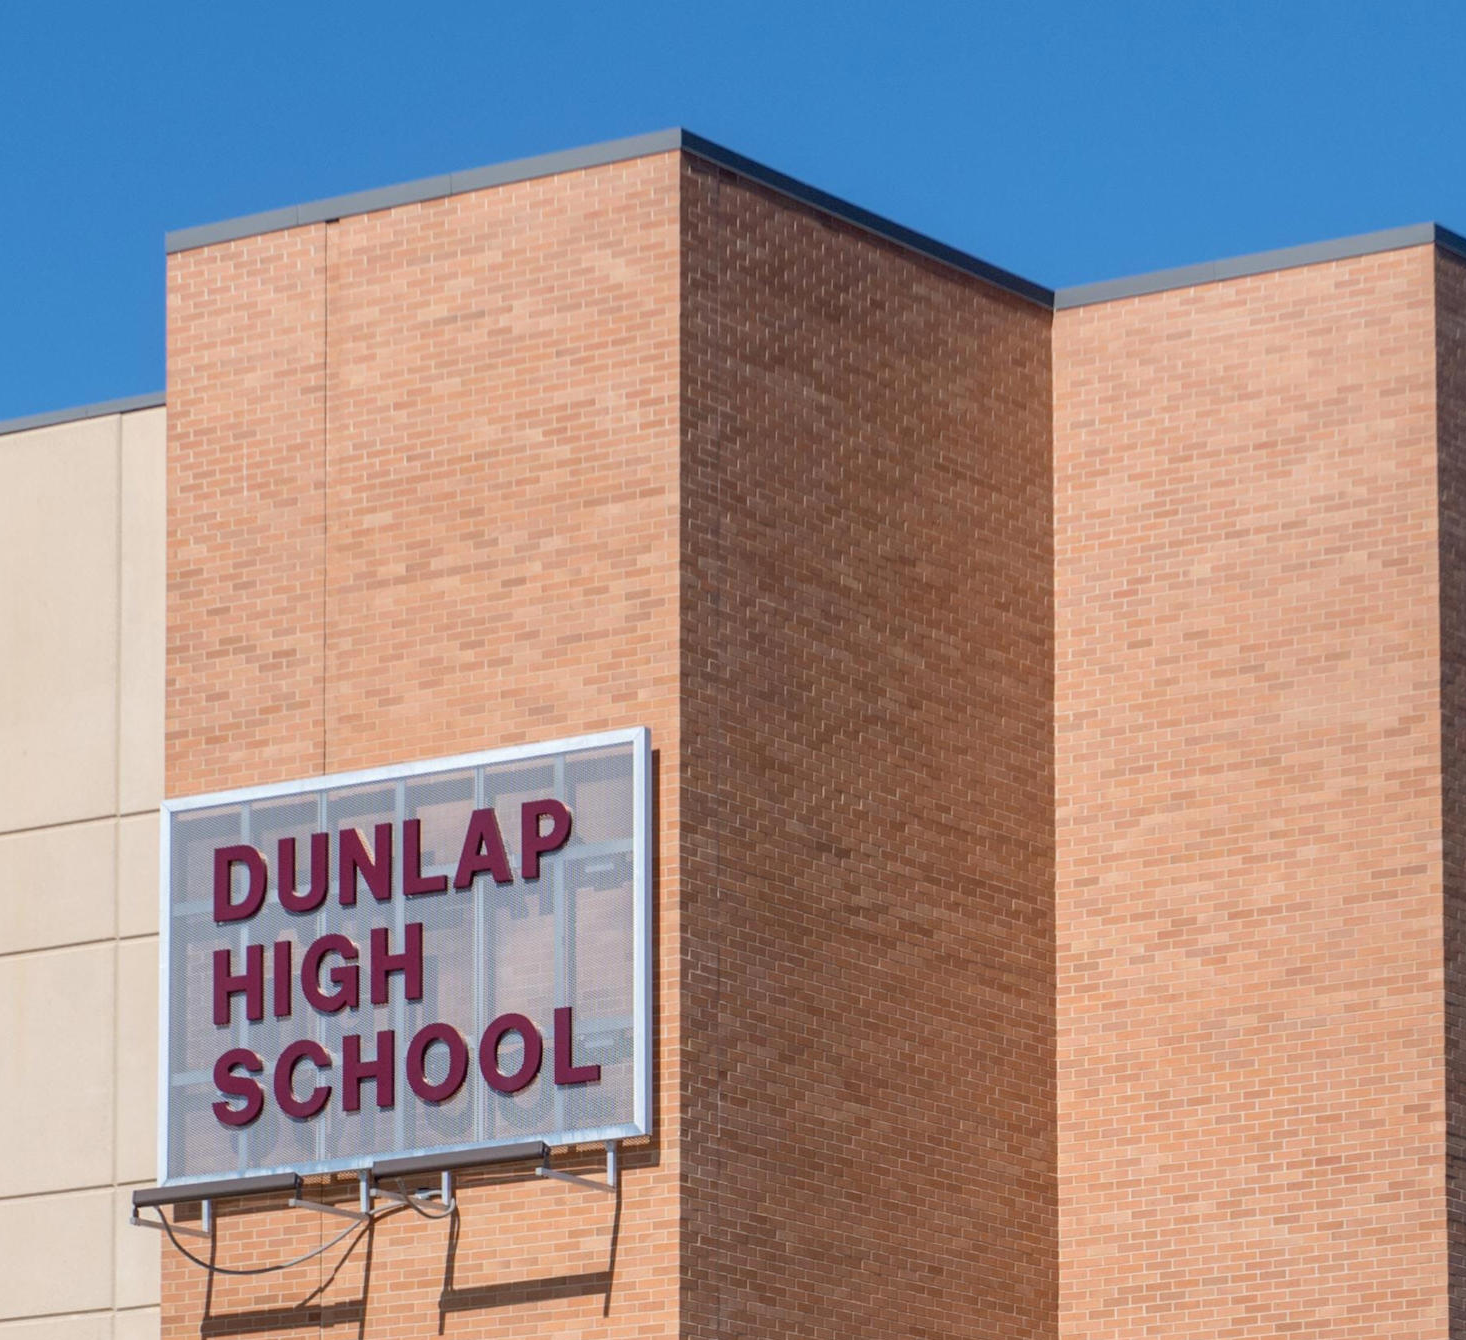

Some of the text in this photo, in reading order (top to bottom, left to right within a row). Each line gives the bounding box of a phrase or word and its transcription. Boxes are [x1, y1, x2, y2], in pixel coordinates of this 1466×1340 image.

[213, 798, 573, 924] DUNLAP
[213, 922, 424, 1026] HIGH
[211, 1006, 602, 1128] SCHOOL
